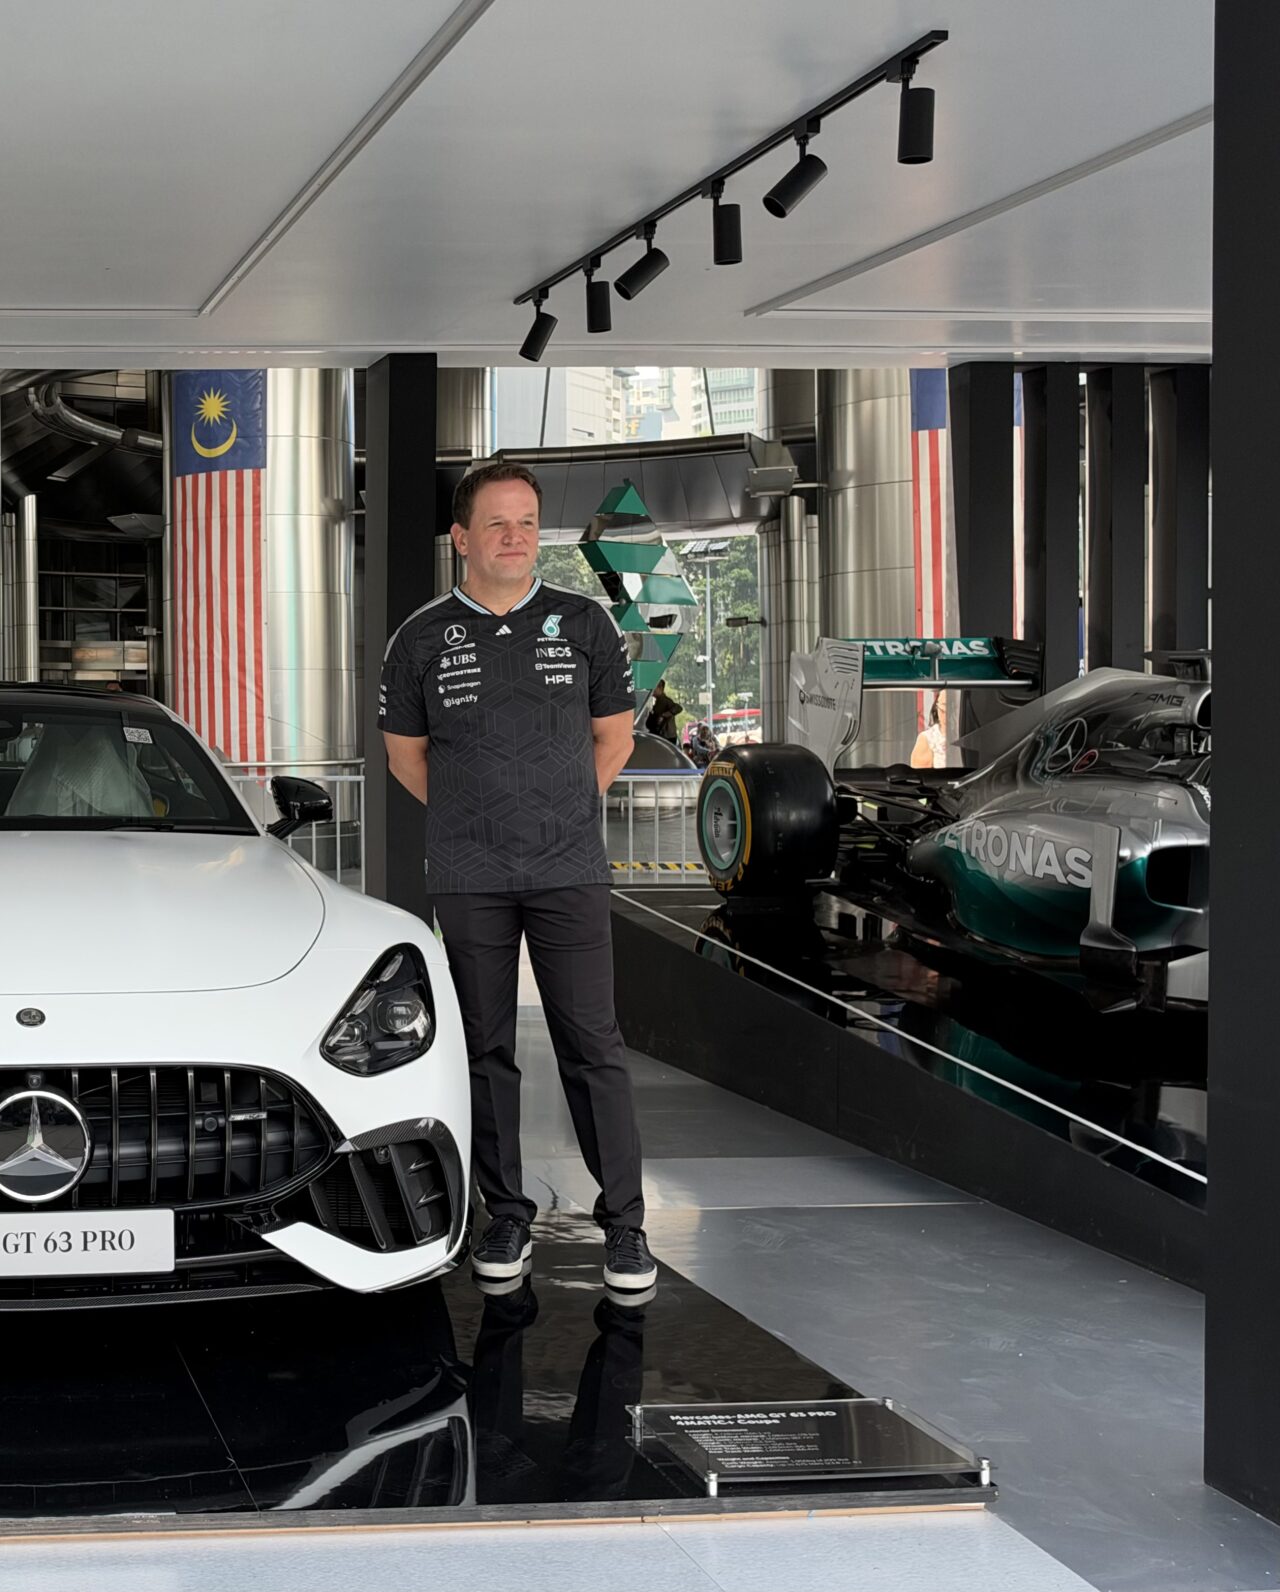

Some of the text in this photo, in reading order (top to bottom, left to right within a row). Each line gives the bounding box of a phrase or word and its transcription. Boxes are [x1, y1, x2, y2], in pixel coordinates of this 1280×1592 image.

[535, 647, 572, 658] INEOS
[452, 652, 477, 666] UBS
[438, 667, 481, 680] CROWDSTRIKE
[544, 674, 573, 685] HPE
[446, 681, 481, 691] Snapdragon
[2, 1231, 37, 1254] GT
[43, 1230, 73, 1254] 63
[80, 1228, 136, 1252] PRO
[669, 1413, 769, 1421] Mercedes-AMG
